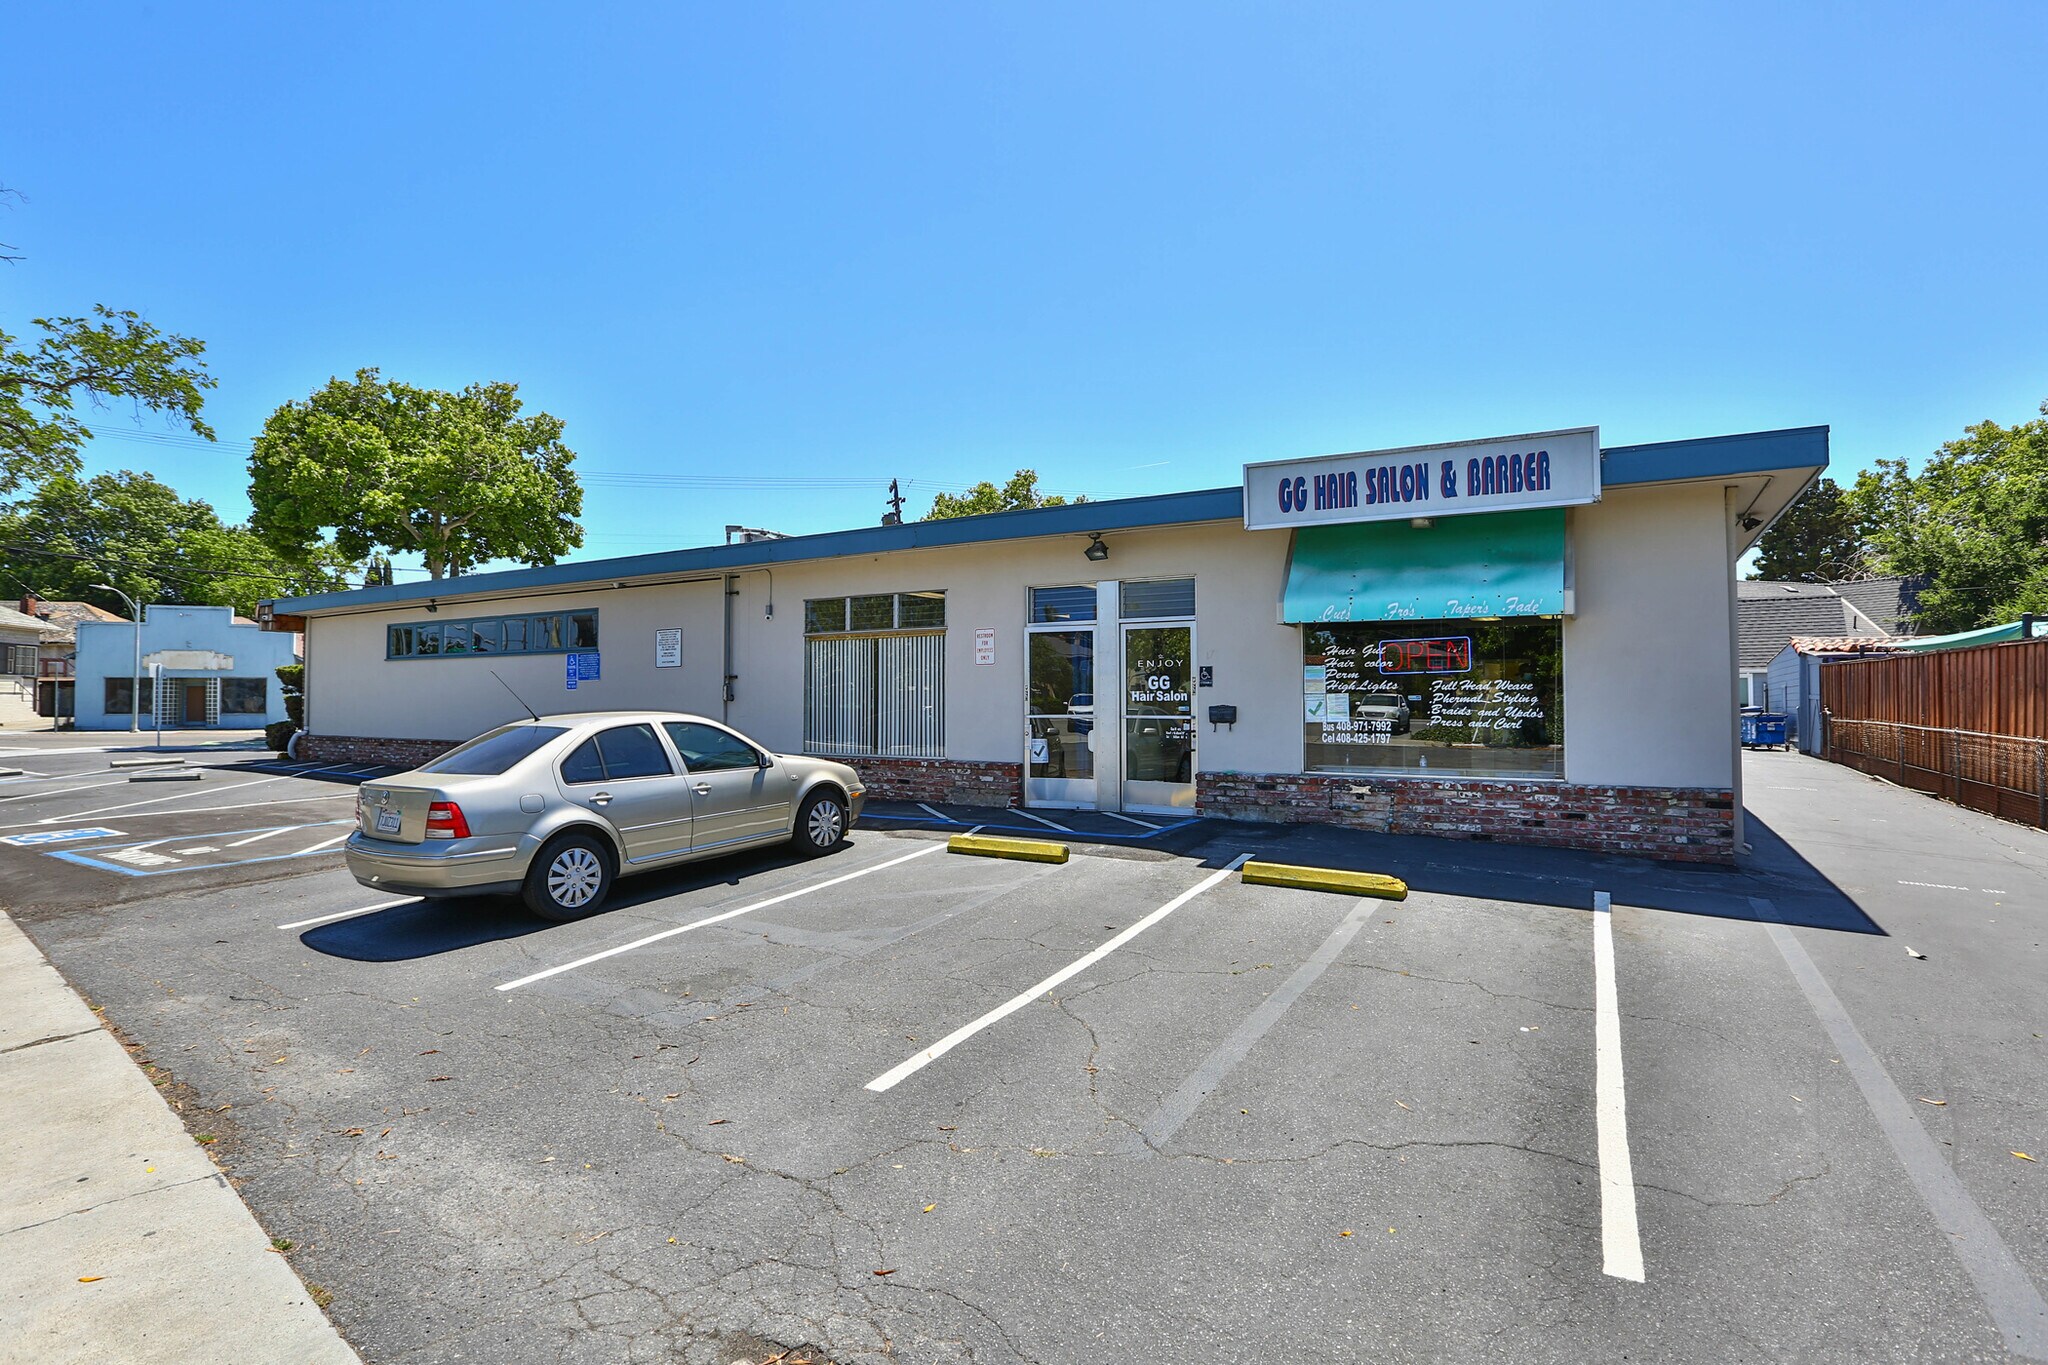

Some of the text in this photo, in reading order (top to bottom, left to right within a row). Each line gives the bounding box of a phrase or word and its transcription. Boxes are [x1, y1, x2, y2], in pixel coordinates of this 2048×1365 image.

[1278, 450, 1551, 513] GG HAIR SALON & BARBER
[1324, 645, 1356, 656] Hair
[1382, 639, 1469, 671] OPEN
[1137, 659, 1183, 668] ENJOY
[1324, 657, 1355, 668] Hair
[1325, 668, 1360, 679] Perm
[1148, 675, 1171, 690] GG
[1431, 679, 1534, 693] Full Head Weave
[1131, 690, 1188, 702] Hair Salon
[1491, 692, 1539, 706] Styling
[1430, 704, 1472, 716] Braids
[1477, 707, 1502, 718] and
[1322, 721, 1392, 732] Bus 408-971-7992
[1429, 715, 1523, 730] Press and Curl
[1321, 733, 1392, 744] Cel 408-425-1797
